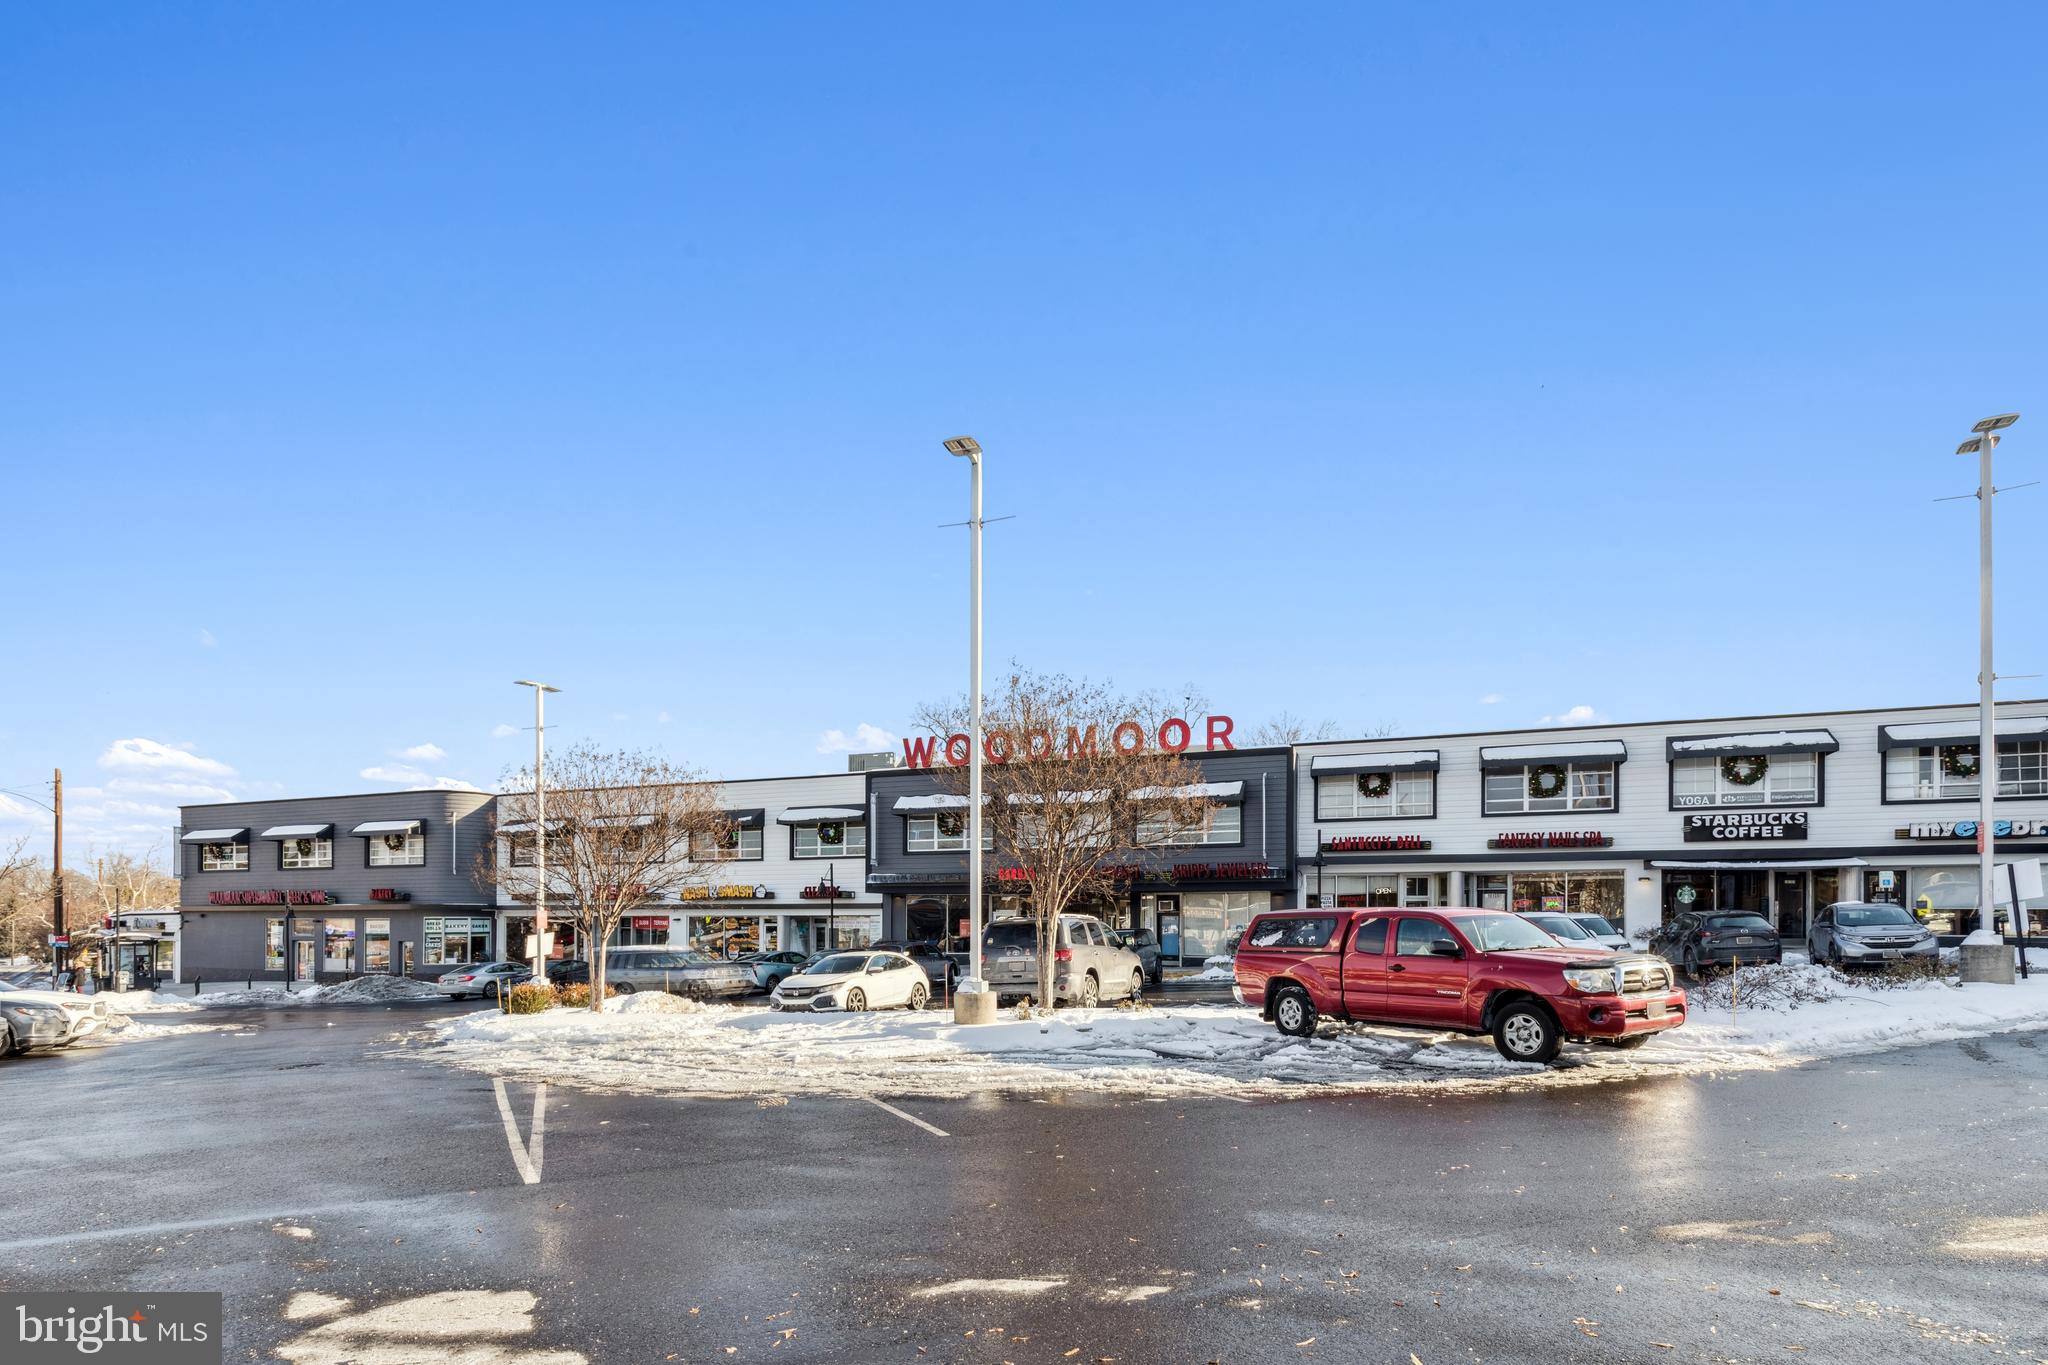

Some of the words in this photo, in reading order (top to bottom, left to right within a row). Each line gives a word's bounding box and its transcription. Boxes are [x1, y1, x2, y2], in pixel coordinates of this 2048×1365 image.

[903, 716, 1234, 768] WOODMOOR
[1679, 796, 1710, 805] YOGA
[1692, 812, 1805, 827] STARBUCKS
[1498, 832, 1544, 848] FANTASY
[1549, 831, 1580, 847] NAILS
[1582, 831, 1604, 847] SPA
[1712, 826, 1784, 839] COFFEE
[1332, 835, 1391, 850] SANTUCCI'S
[1397, 835, 1421, 849] DELI
[1172, 864, 1210, 880] KRIPPS
[1216, 862, 1270, 880] JEWELERS
[717, 885, 753, 898] SMASH
[1375, 887, 1392, 895] OPEN
